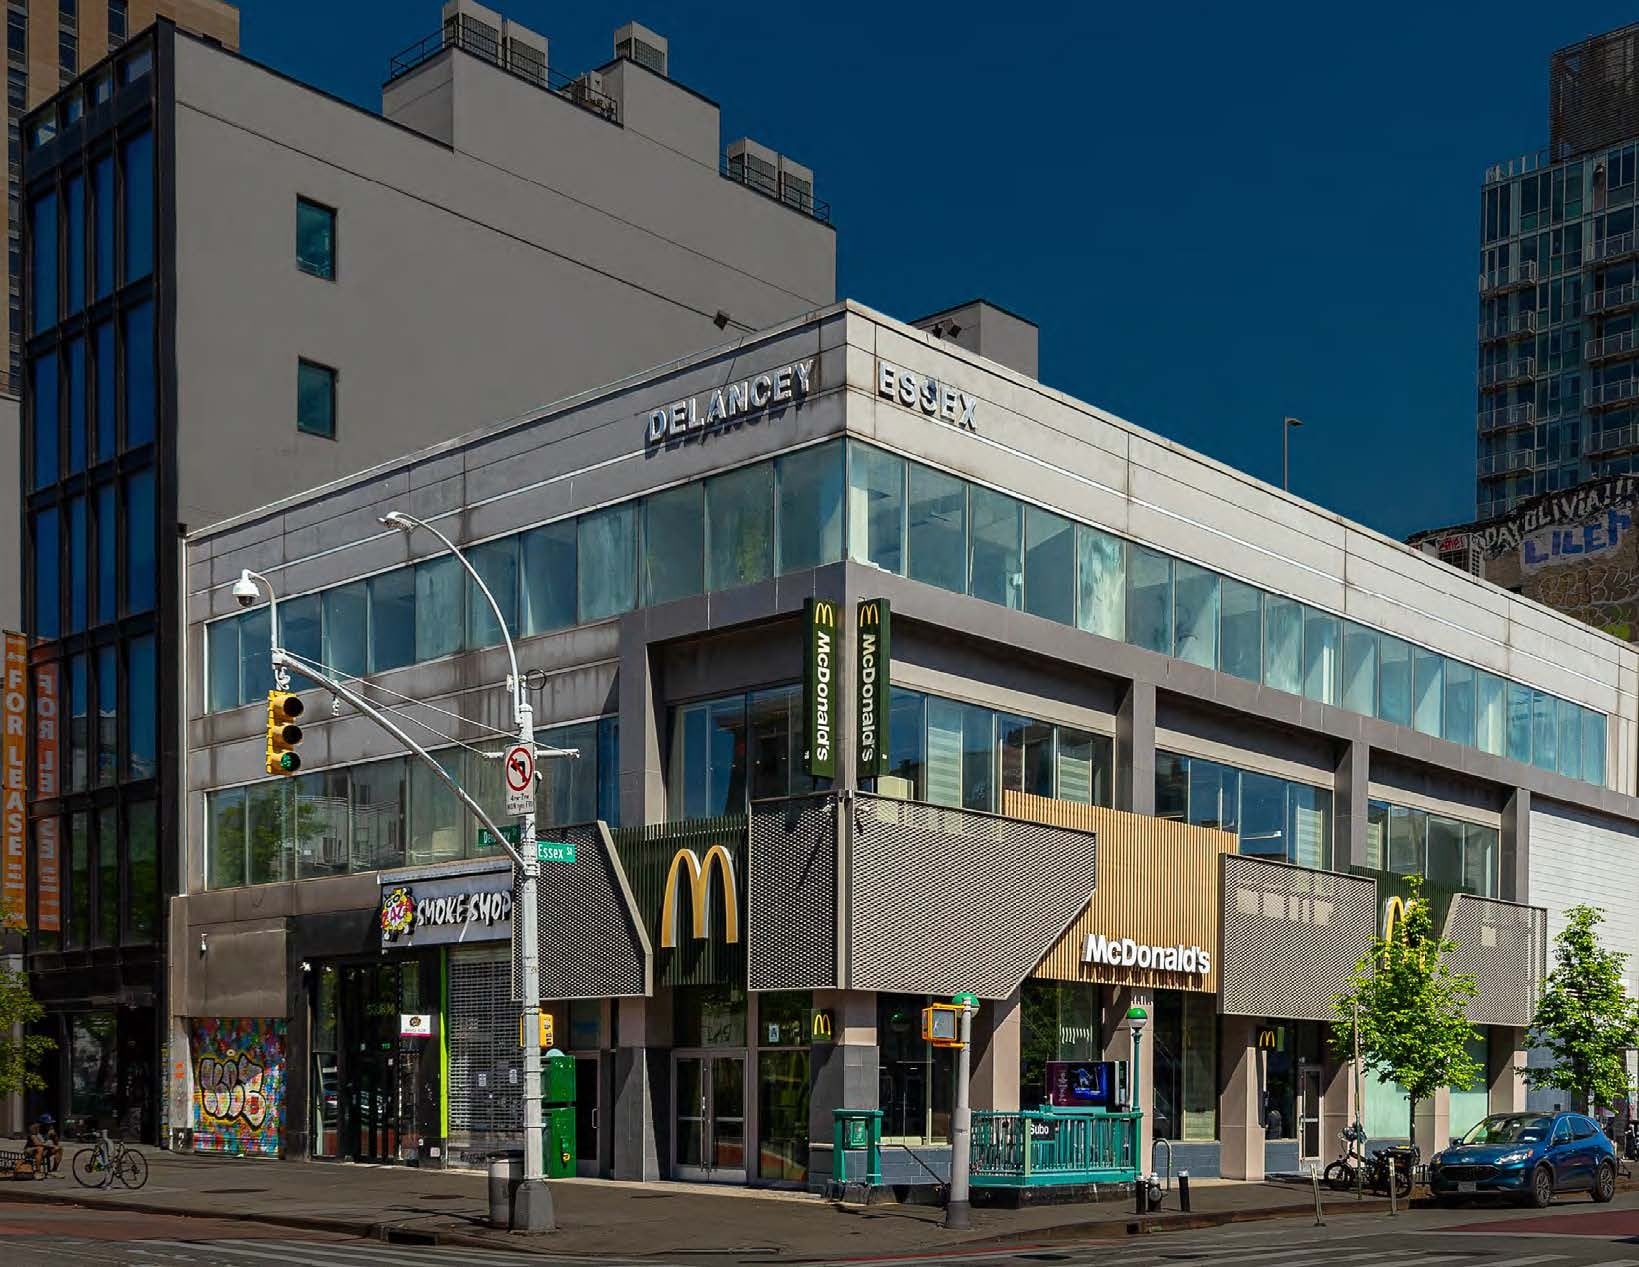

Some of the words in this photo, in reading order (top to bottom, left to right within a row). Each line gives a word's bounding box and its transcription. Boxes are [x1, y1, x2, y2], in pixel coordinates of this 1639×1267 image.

[649, 359, 814, 442] DELANCEY
[877, 360, 978, 431] ESSEX
[6, 669, 25, 736] FOR
[816, 630, 831, 761] McDonald's
[861, 634, 876, 762] McDonald's
[7, 746, 25, 856] LEASE
[538, 843, 564, 859] Essex
[416, 894, 467, 926] SMOKE
[459, 889, 512, 941] SHOP
[1081, 933, 1211, 973] McDonald's
